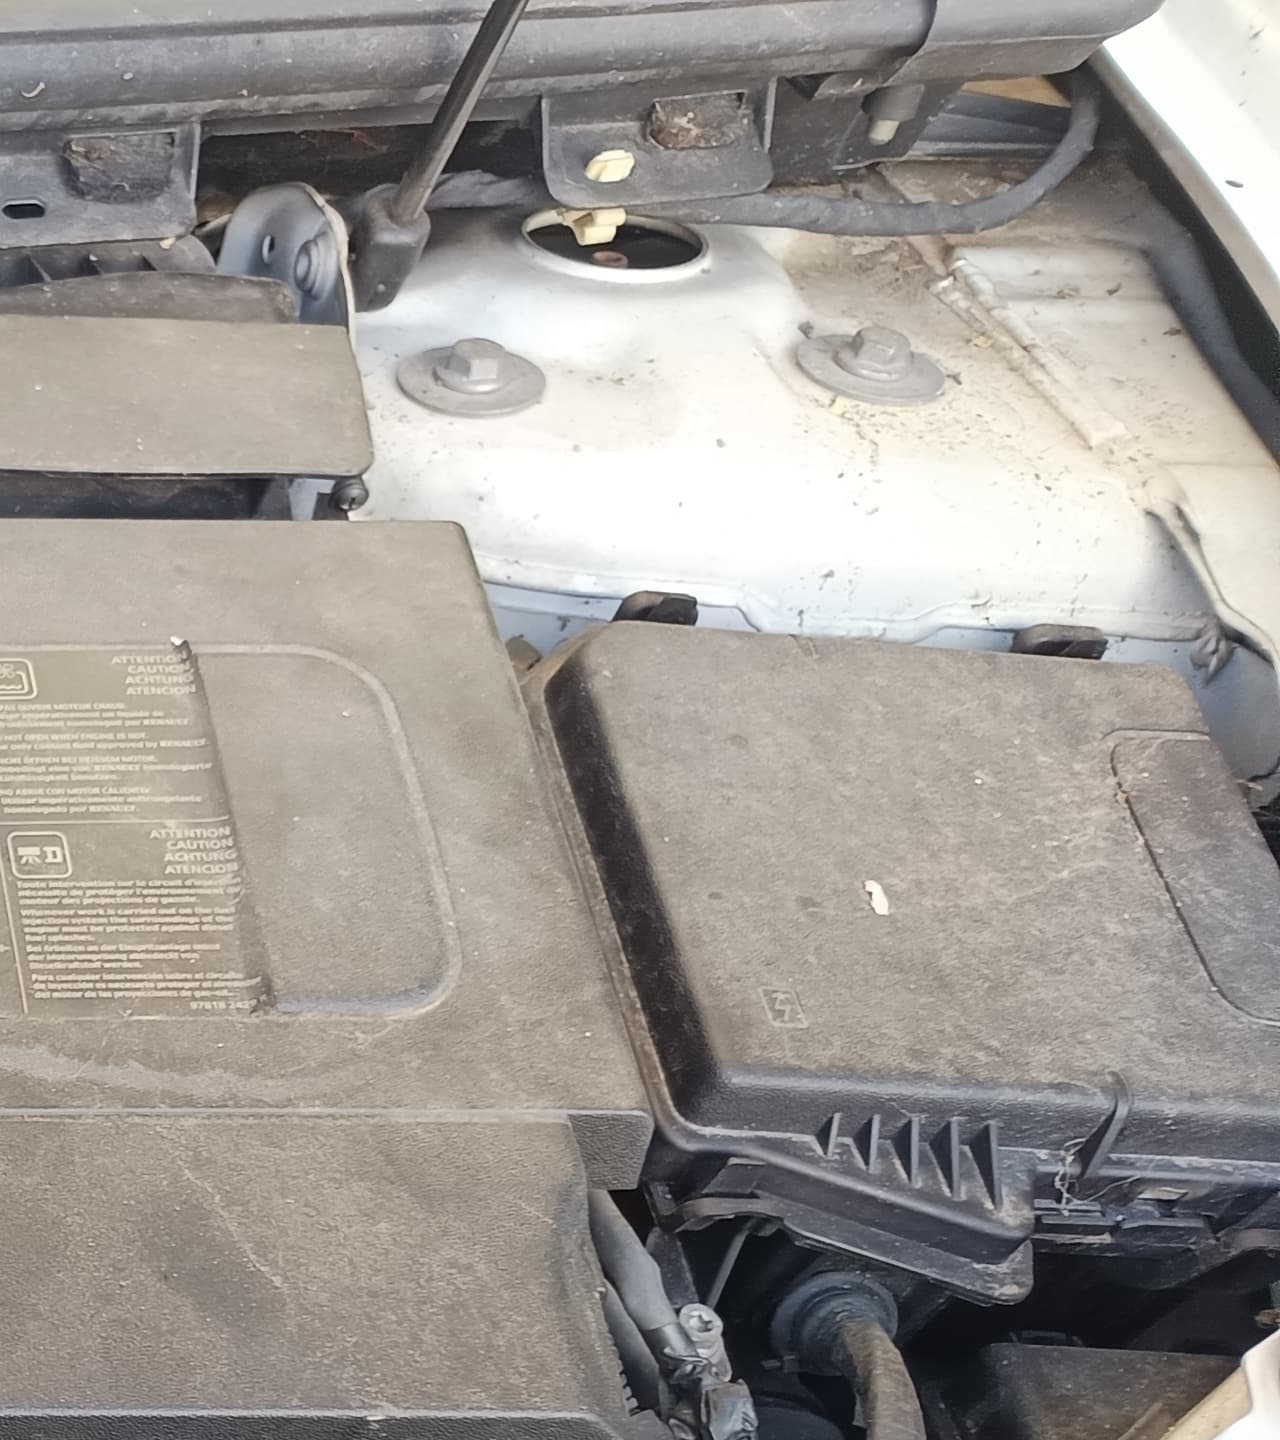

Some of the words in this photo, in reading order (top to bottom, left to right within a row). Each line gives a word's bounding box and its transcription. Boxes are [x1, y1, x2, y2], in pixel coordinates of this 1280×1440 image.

[125, 675, 194, 684] ACHTUNG
[126, 685, 196, 695] ATENCION
[150, 827, 230, 838] ATTENTION
[166, 838, 234, 850] CAUTION
[164, 850, 238, 861] ACHTUNG
[164, 862, 238, 874] ATENCION
